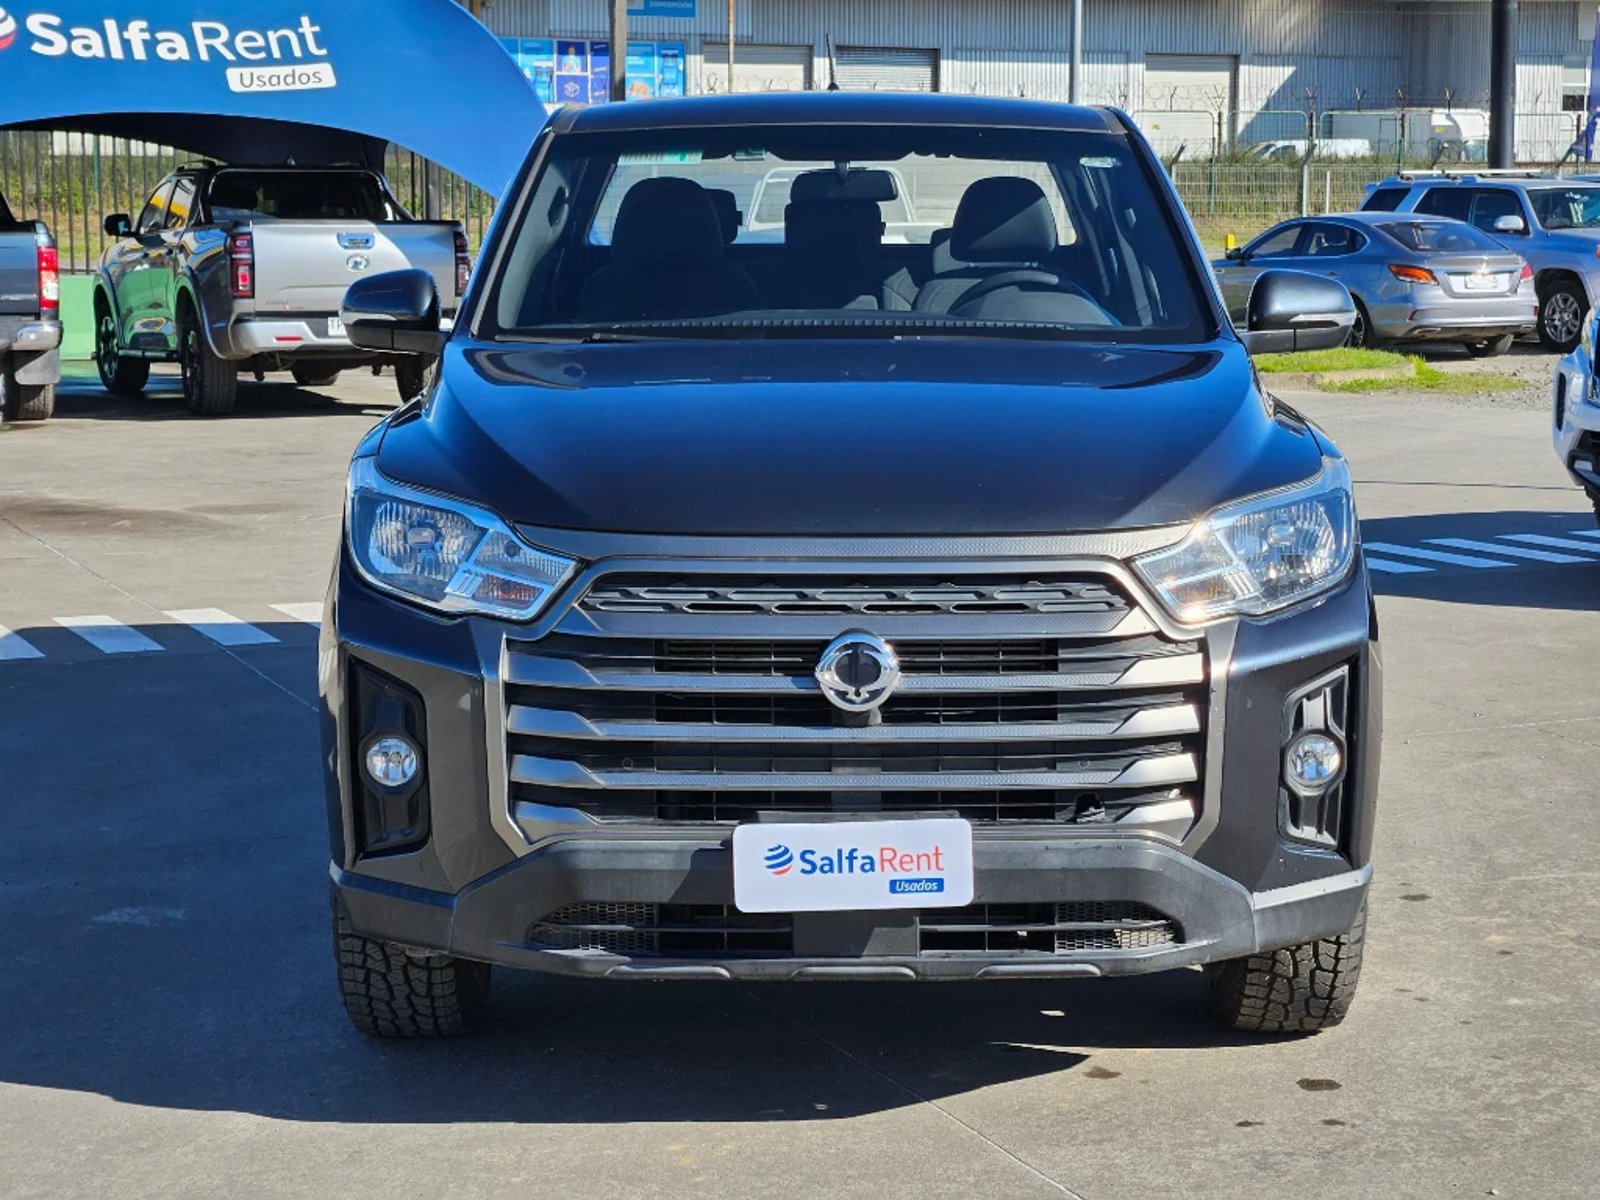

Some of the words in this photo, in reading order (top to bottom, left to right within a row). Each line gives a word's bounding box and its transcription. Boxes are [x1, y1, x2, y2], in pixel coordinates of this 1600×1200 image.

[26, 13, 328, 61] SalfaRent
[239, 68, 323, 88] Usados
[799, 845, 944, 875] SalfaRent
[895, 879, 938, 892] Usados
